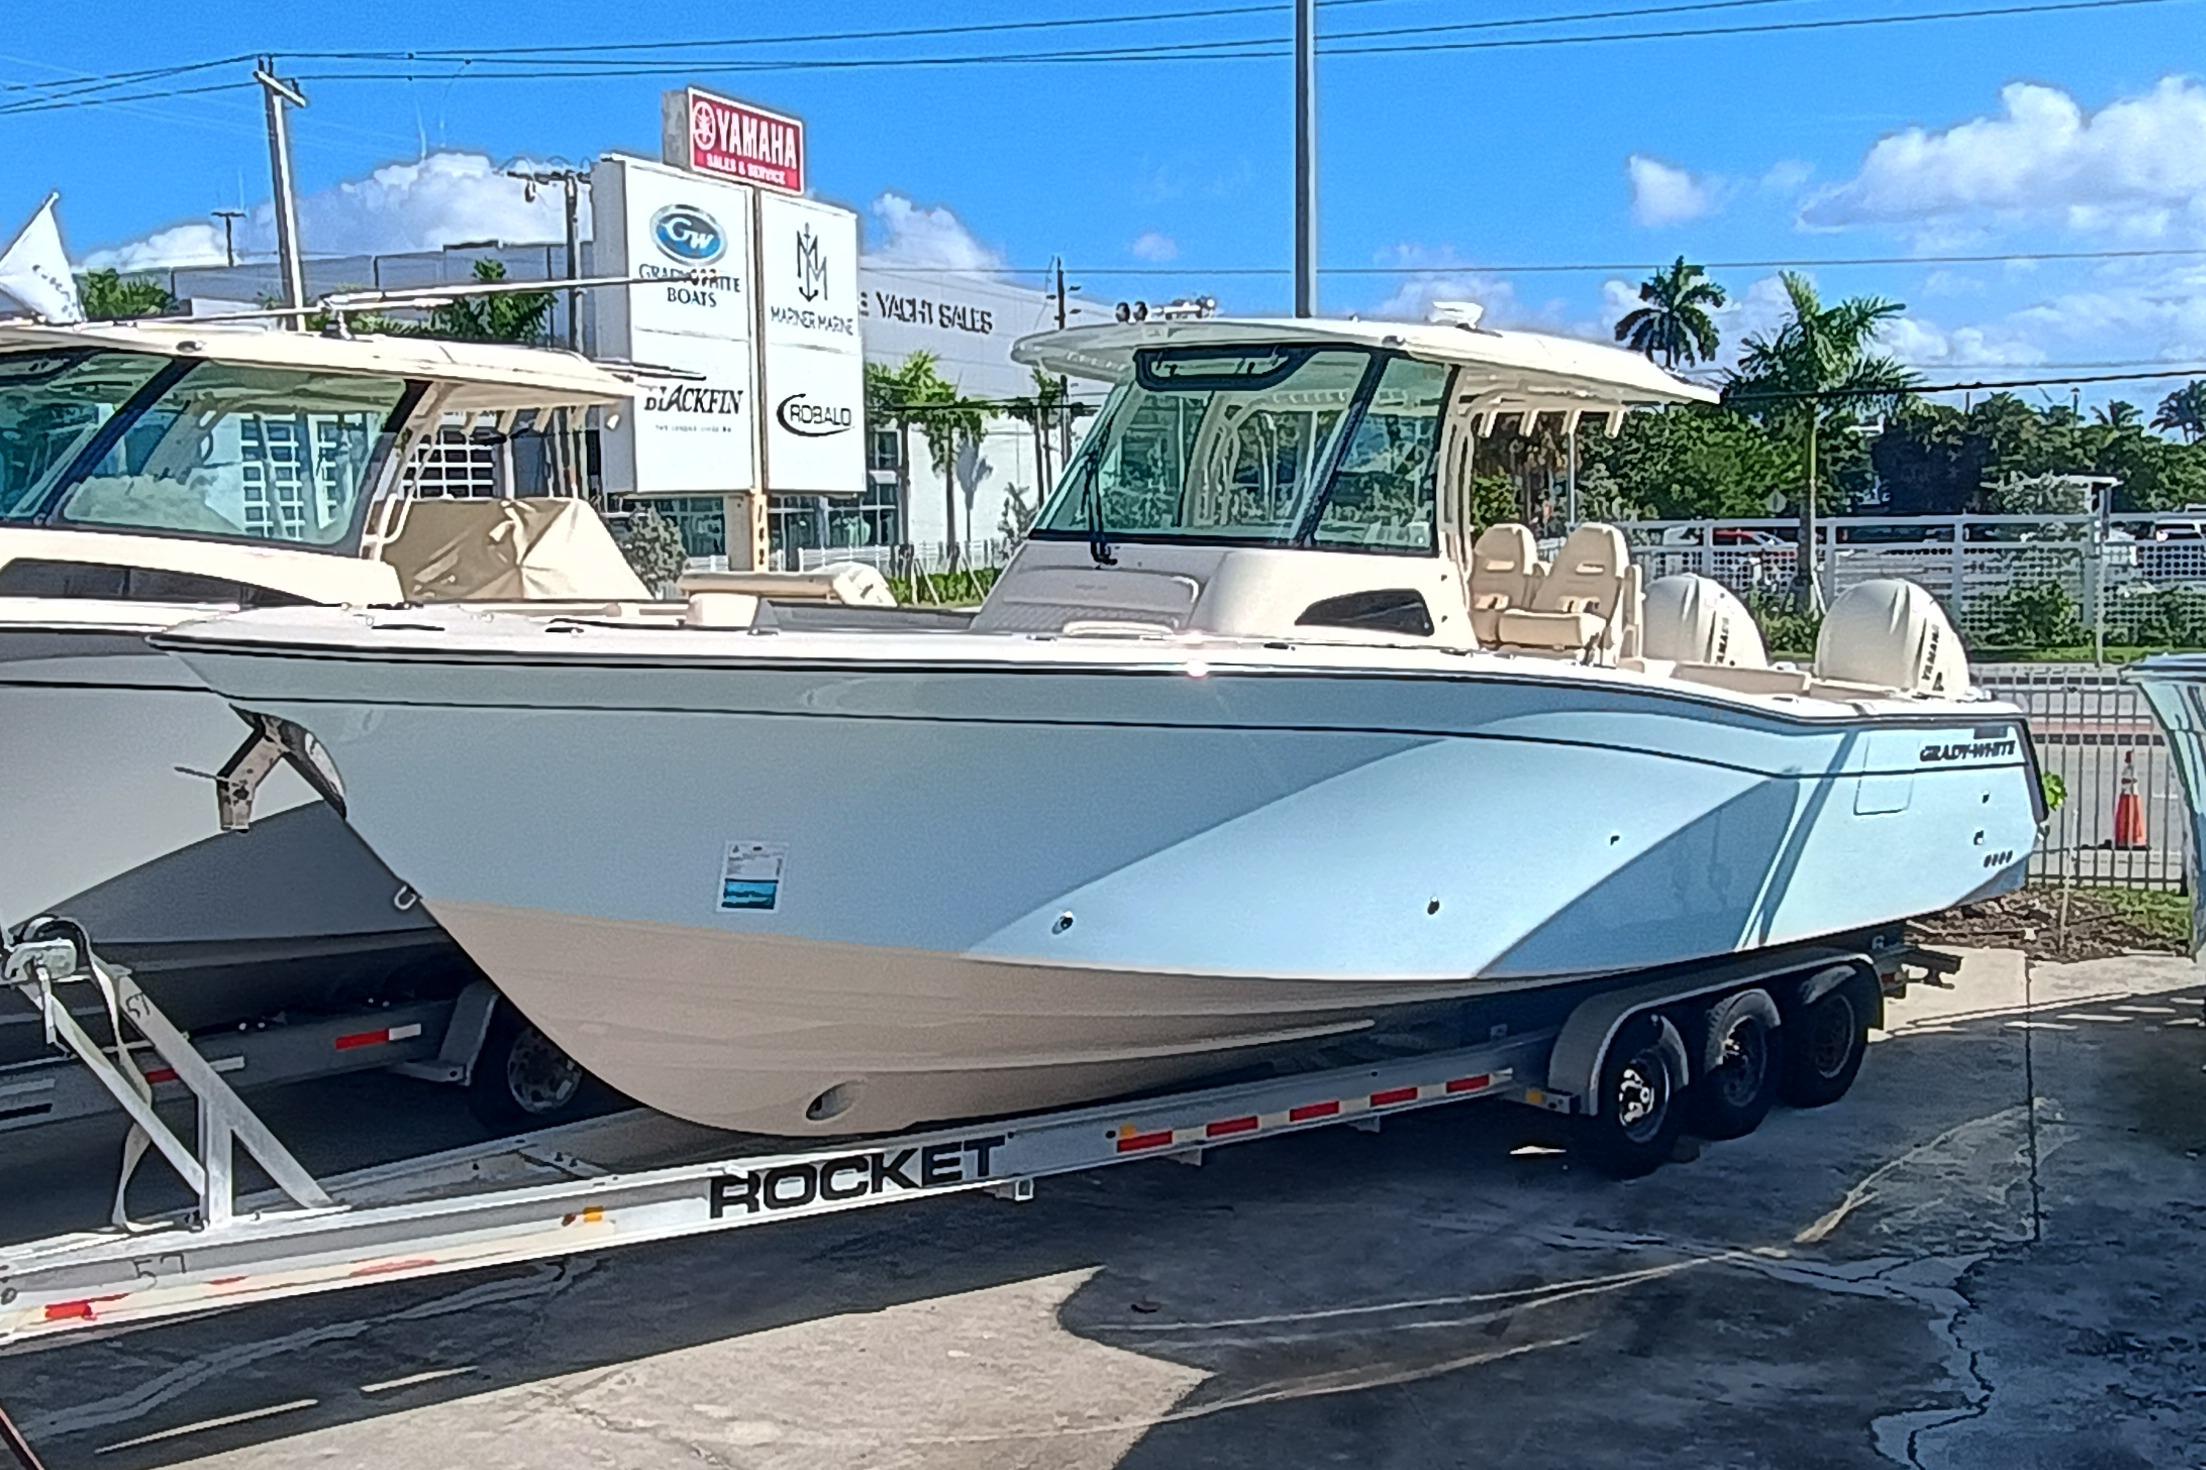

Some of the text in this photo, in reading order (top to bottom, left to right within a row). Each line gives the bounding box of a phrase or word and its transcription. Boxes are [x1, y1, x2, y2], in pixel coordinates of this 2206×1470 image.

[716, 108, 797, 169] YAMAHA
[706, 152, 786, 185] SALES & SERVICE
[667, 286, 717, 308] BOATS
[875, 291, 933, 325] YACHT
[939, 303, 993, 335] SALES
[644, 384, 744, 414] BLACKFIN
[790, 404, 851, 427] ROBALO
[1920, 740, 2016, 762] GRADY-WHITE
[710, 1135, 1005, 1218] ROCKET
[133, 1252, 186, 1291] 57
